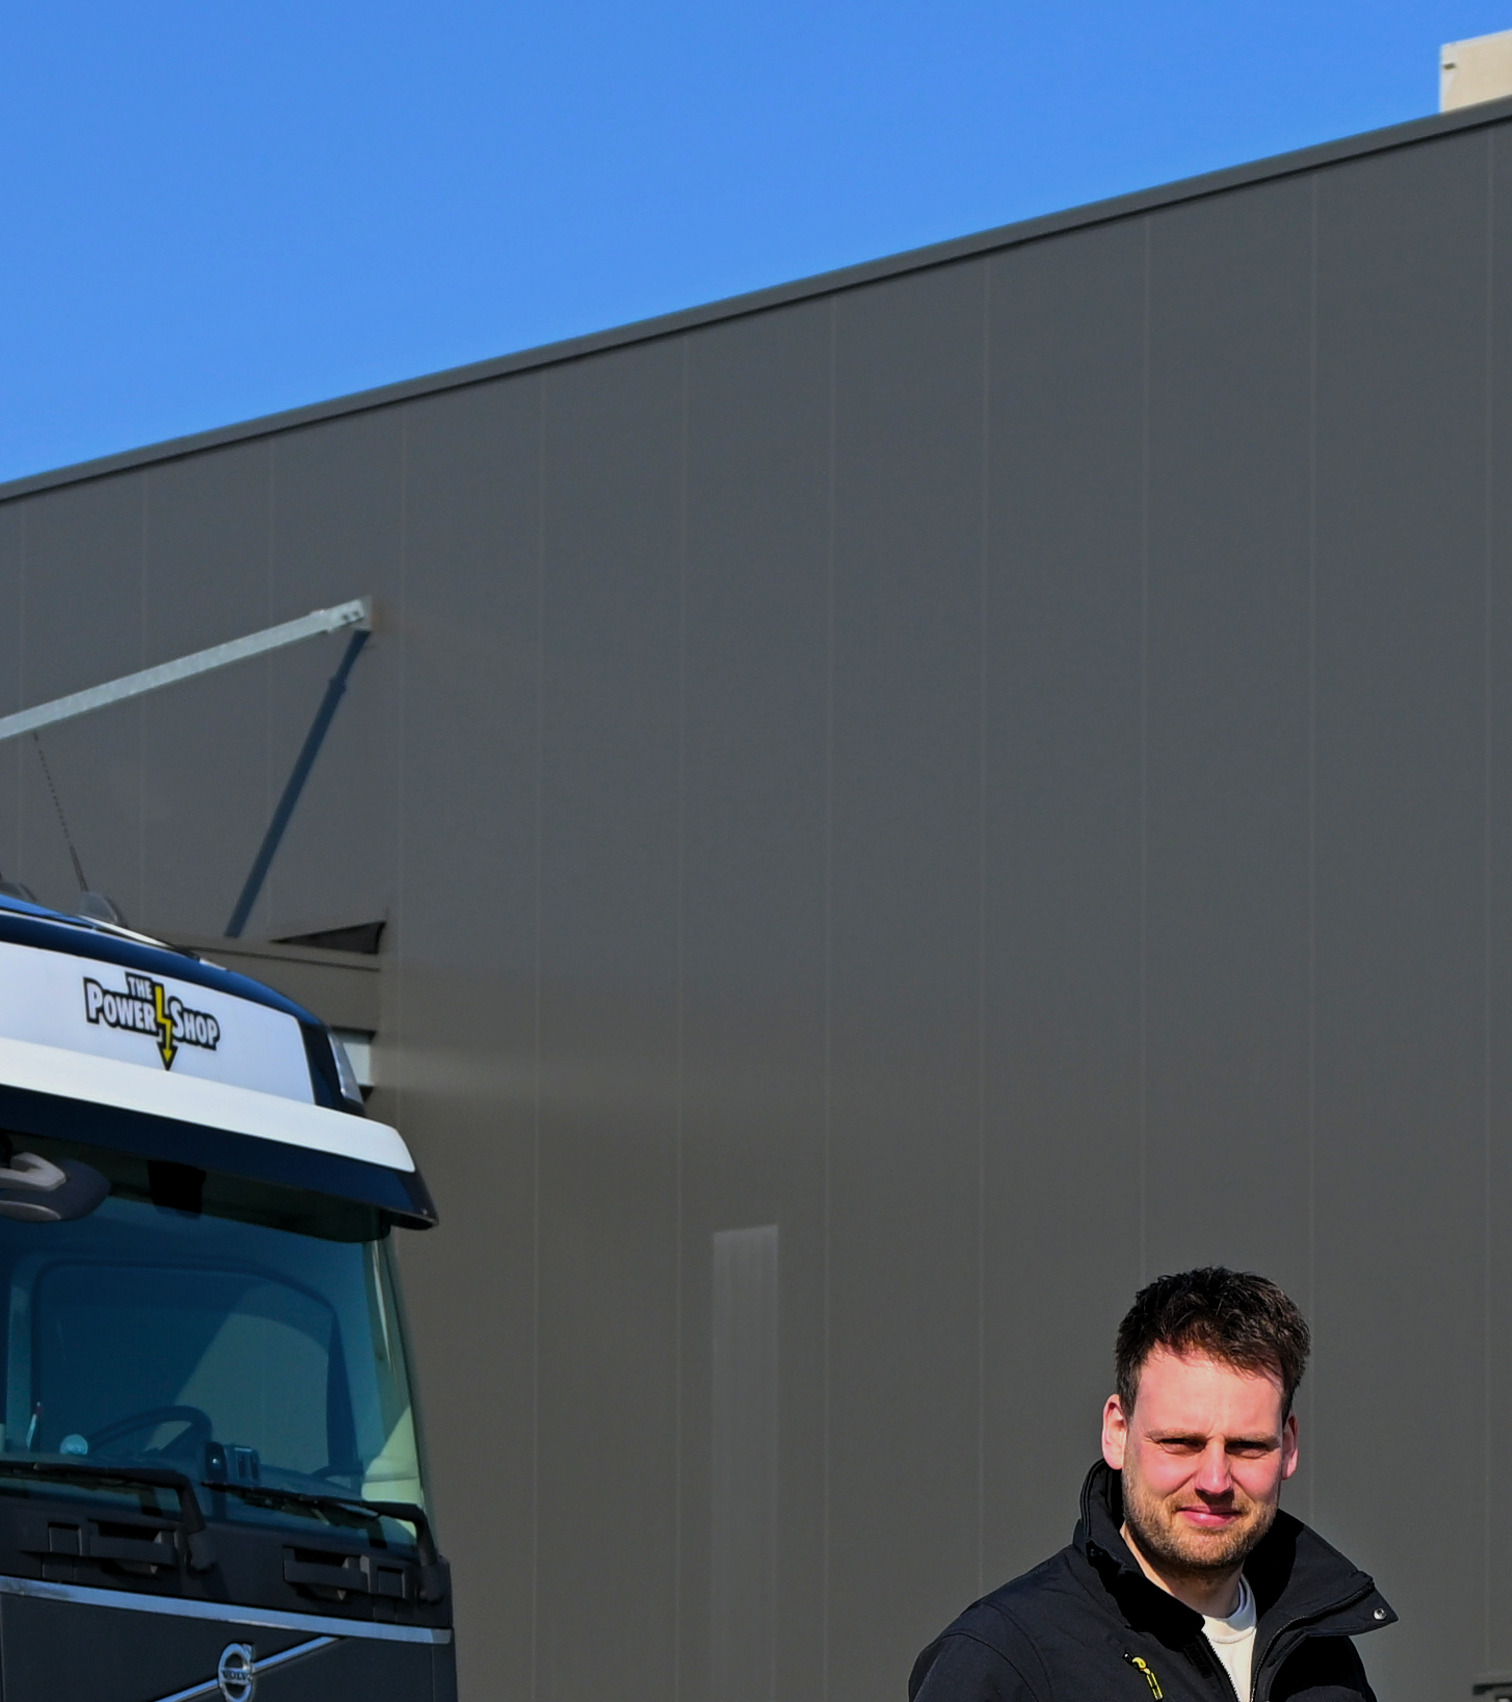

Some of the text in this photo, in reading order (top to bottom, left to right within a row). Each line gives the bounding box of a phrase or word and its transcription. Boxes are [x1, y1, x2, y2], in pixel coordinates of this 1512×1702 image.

[127, 976, 153, 1001] THE
[85, 981, 219, 1046] POWER SHOP
